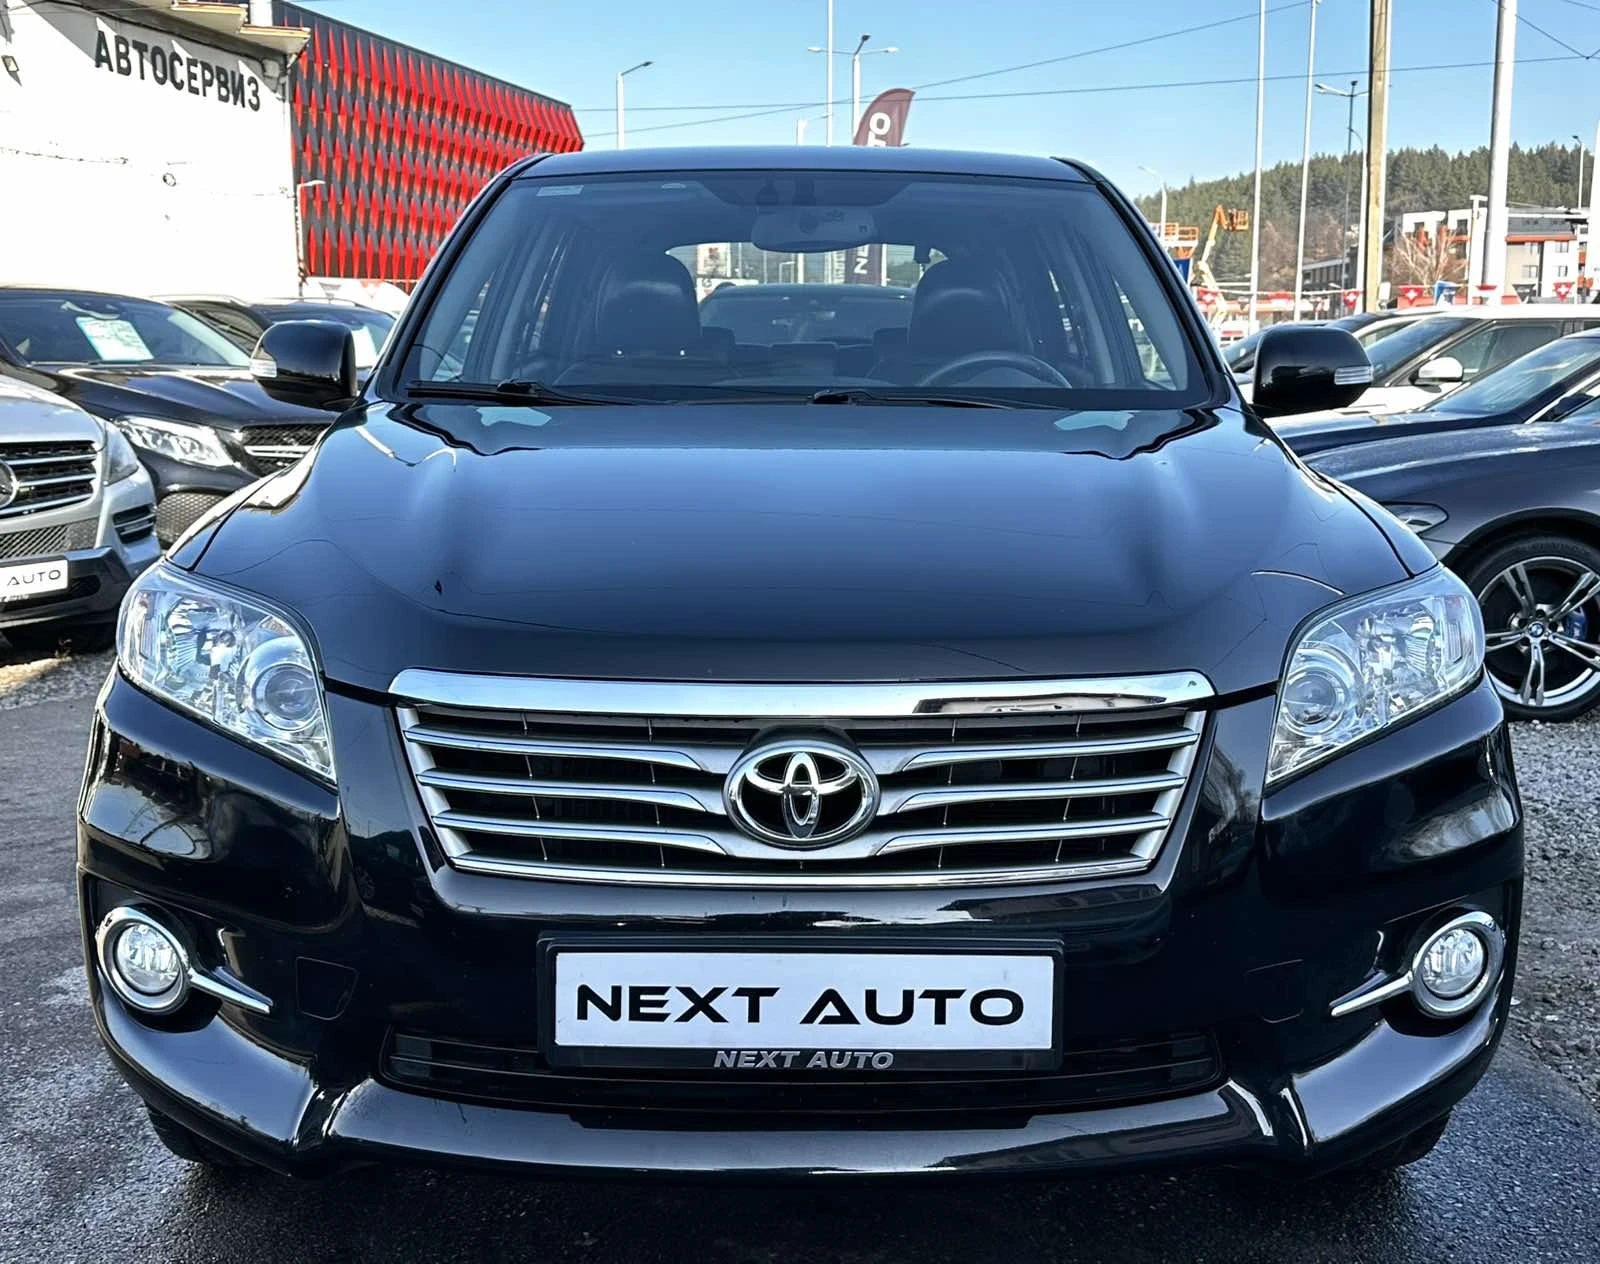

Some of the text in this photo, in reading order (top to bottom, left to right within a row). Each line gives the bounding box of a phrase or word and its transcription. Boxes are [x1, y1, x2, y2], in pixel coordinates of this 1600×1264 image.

[95, 30, 260, 112] АВТОСЕРВИЗ
[7, 569, 61, 586] AUTO
[577, 984, 1024, 1025] NEXT AUTO
[713, 1050, 894, 1069] NEXT AUTO
